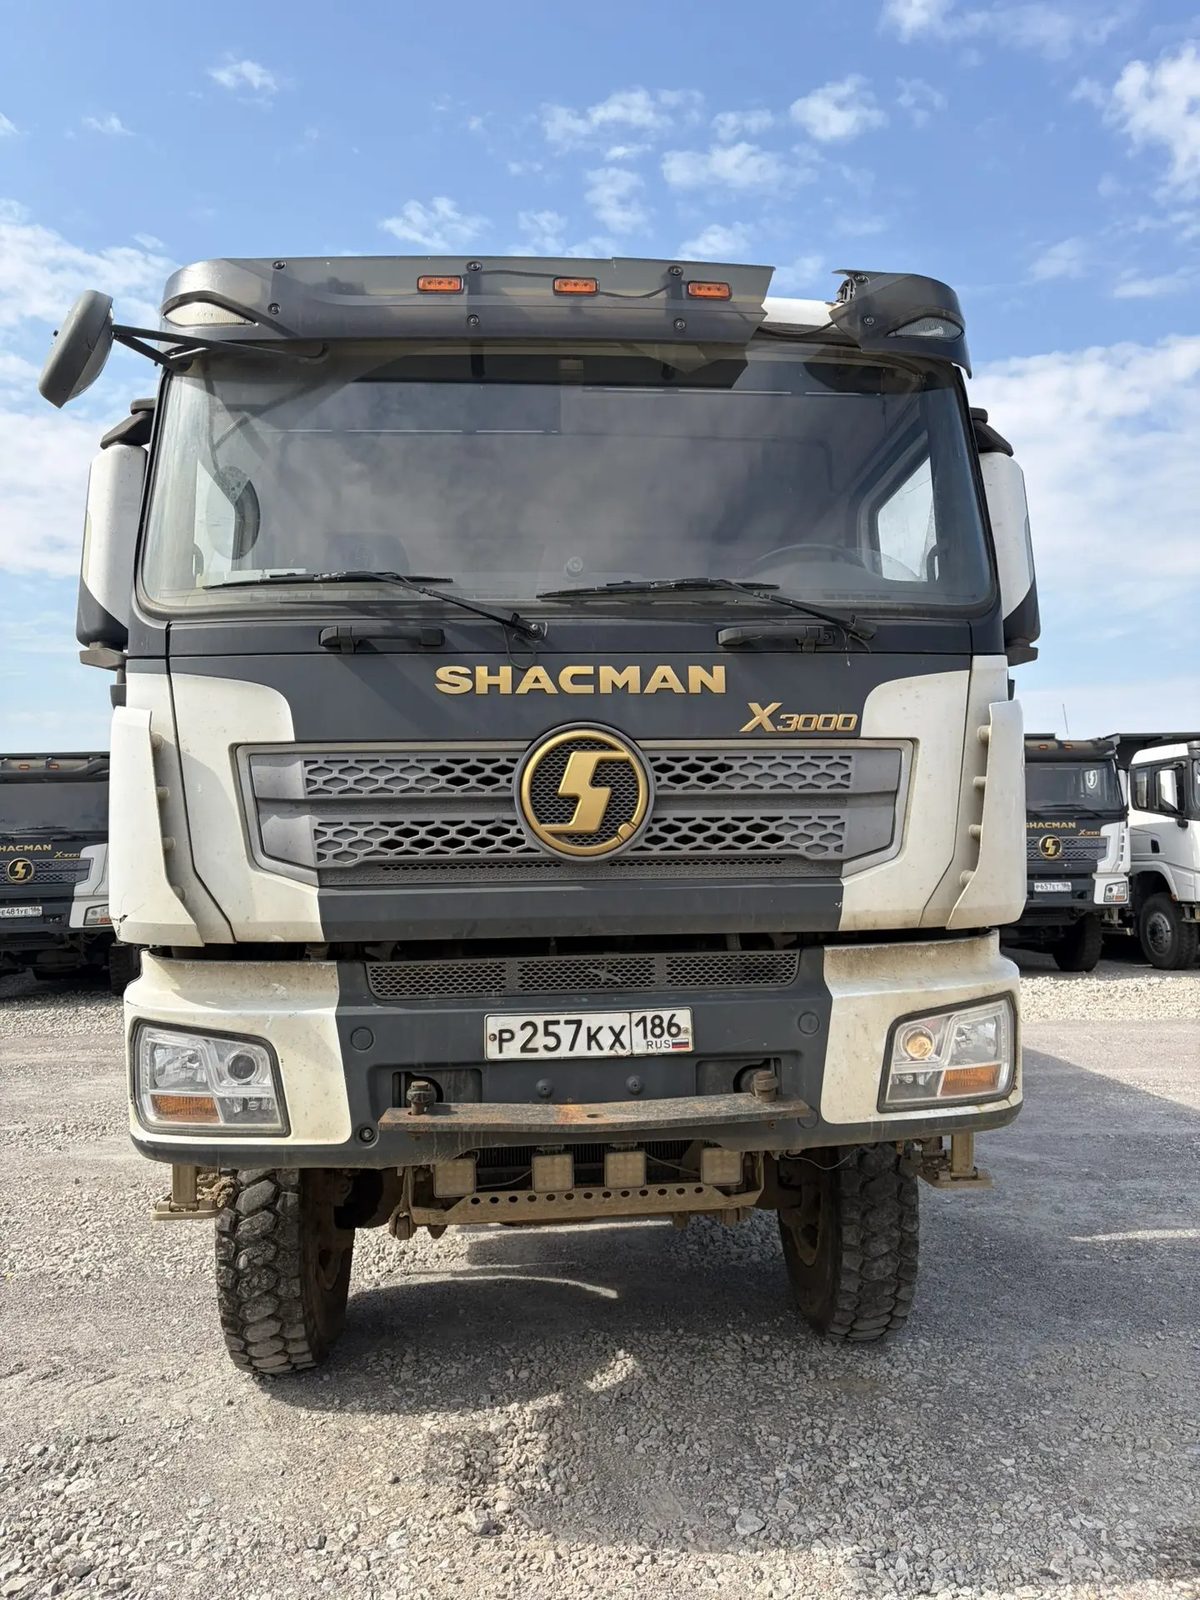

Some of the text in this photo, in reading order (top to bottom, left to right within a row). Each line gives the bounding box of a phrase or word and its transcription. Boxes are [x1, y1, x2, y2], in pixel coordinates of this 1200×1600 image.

[435, 665, 726, 695] SHACMAN
[739, 701, 859, 733] X3000
[634, 1013, 682, 1040] 186
[646, 1038, 671, 1050] RUS
